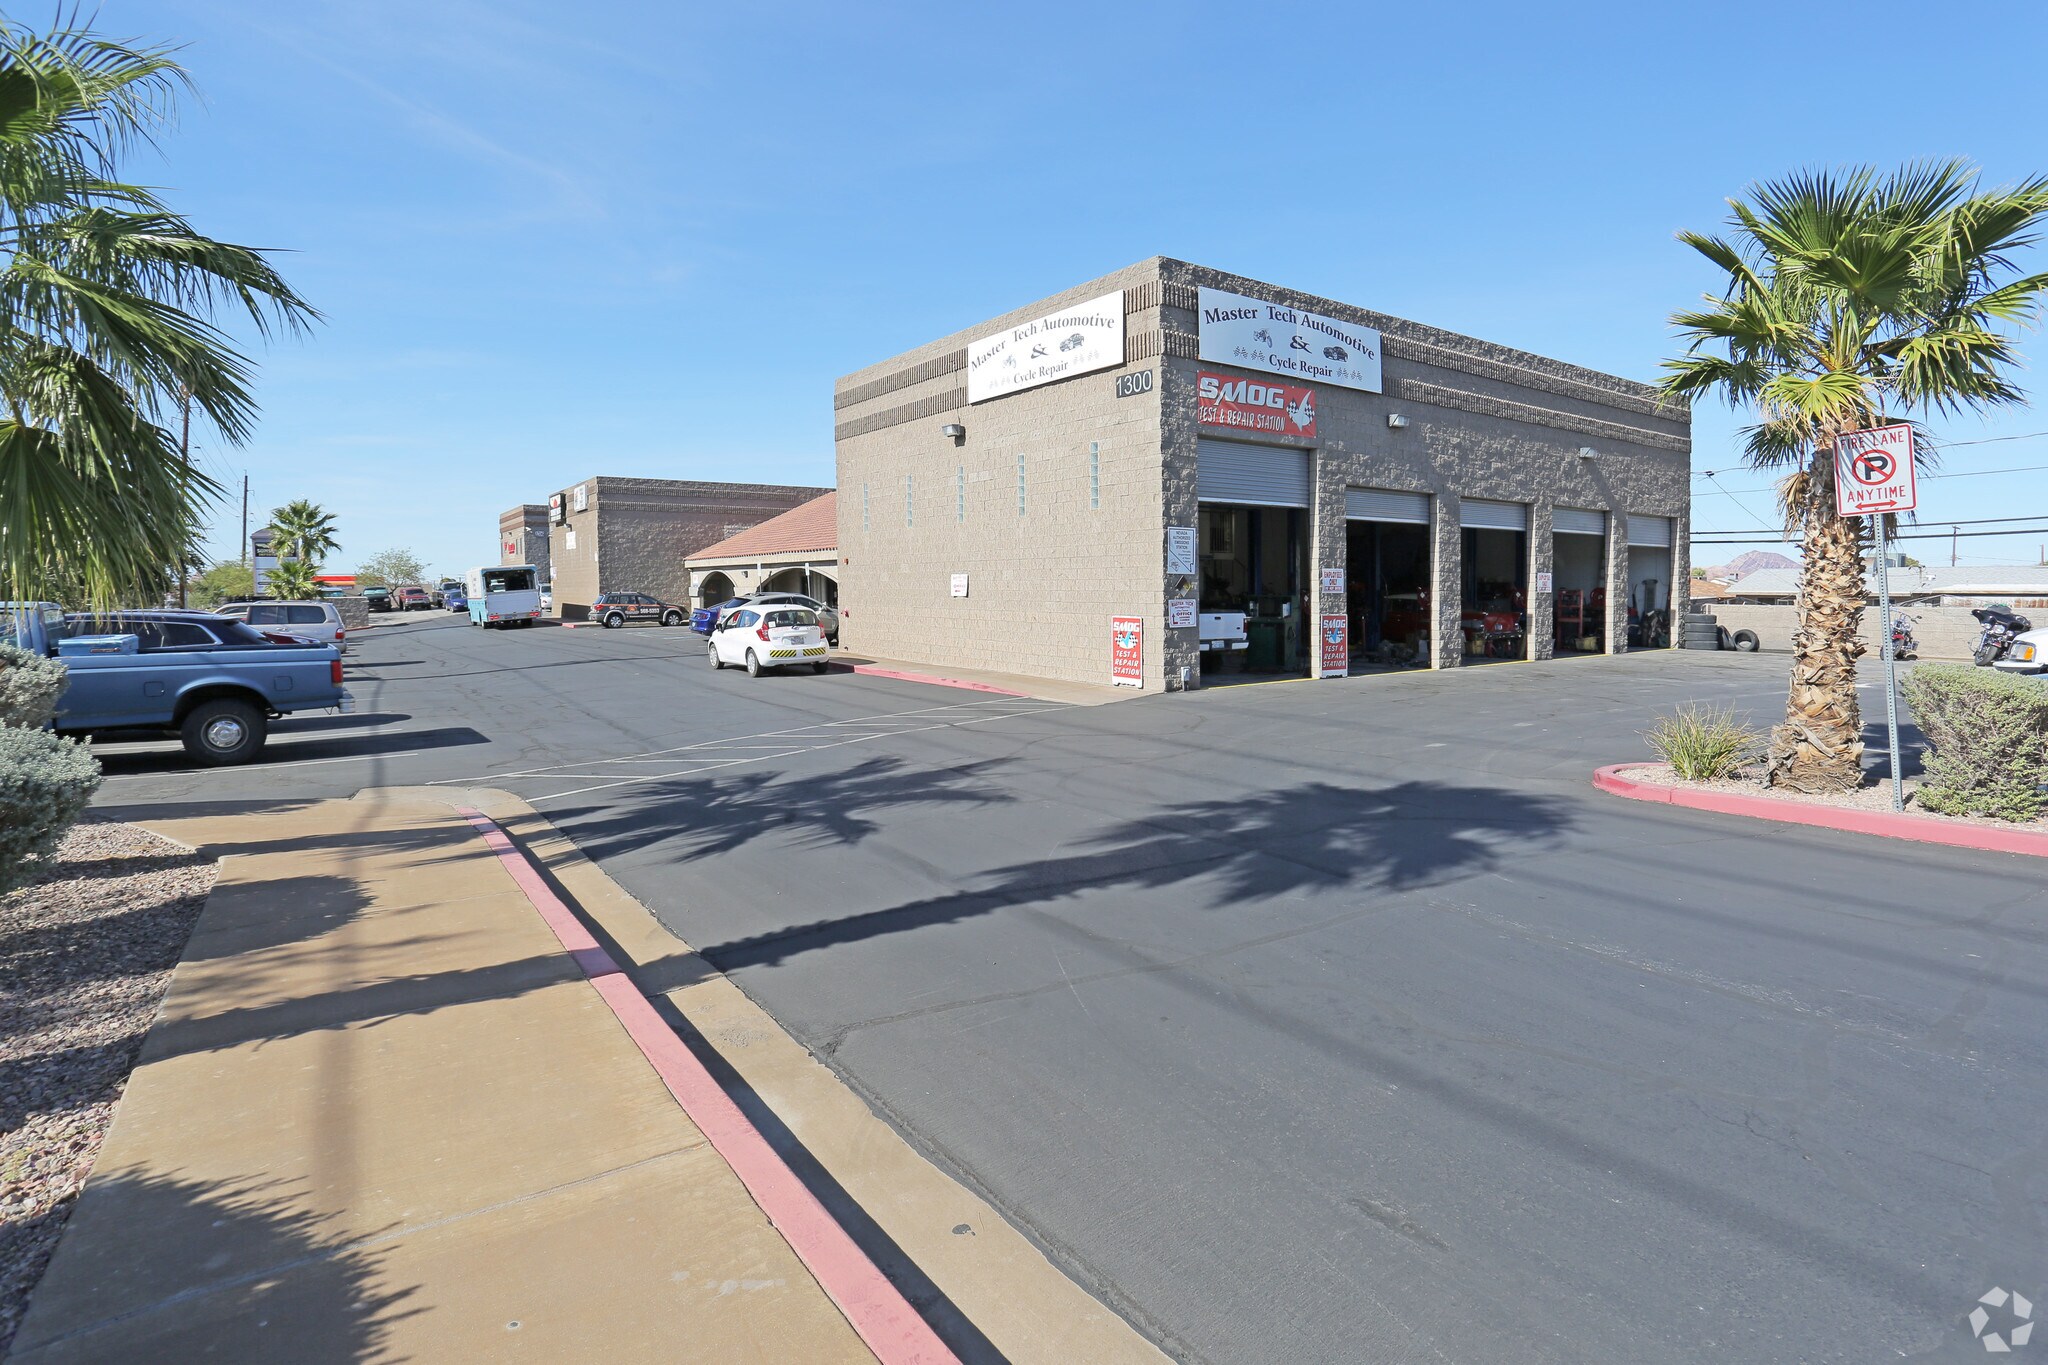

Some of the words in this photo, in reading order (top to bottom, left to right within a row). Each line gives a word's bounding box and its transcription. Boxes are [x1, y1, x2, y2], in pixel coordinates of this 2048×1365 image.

[970, 339, 1006, 372] Master
[1011, 321, 1038, 343] Tech
[1040, 312, 1115, 333] Automotive
[1204, 307, 1258, 324] Master
[1266, 305, 1298, 324] Tech
[1301, 314, 1375, 361] Automotive
[1030, 342, 1049, 360] &
[1289, 335, 1313, 355] &
[1013, 369, 1037, 385] Cycle
[1038, 360, 1069, 378] Repair
[1268, 354, 1297, 371] Cycle
[1300, 361, 1333, 378] Repair
[1116, 371, 1152, 396] 1300
[1199, 377, 1284, 409] SMOG
[1199, 405, 1218, 422] TEST
[1219, 408, 1226, 423] &
[1228, 410, 1254, 428] REPAIR
[1256, 414, 1286, 432] STATION
[1840, 437, 1865, 451] FIRE
[1873, 430, 1904, 447] LANE
[1847, 485, 1907, 503] ANYTIME
[1113, 621, 1140, 632] SMOG
[1323, 619, 1346, 630] SMOG
[1114, 658, 1139, 667] REPAIR
[1114, 667, 1140, 676] STATION
